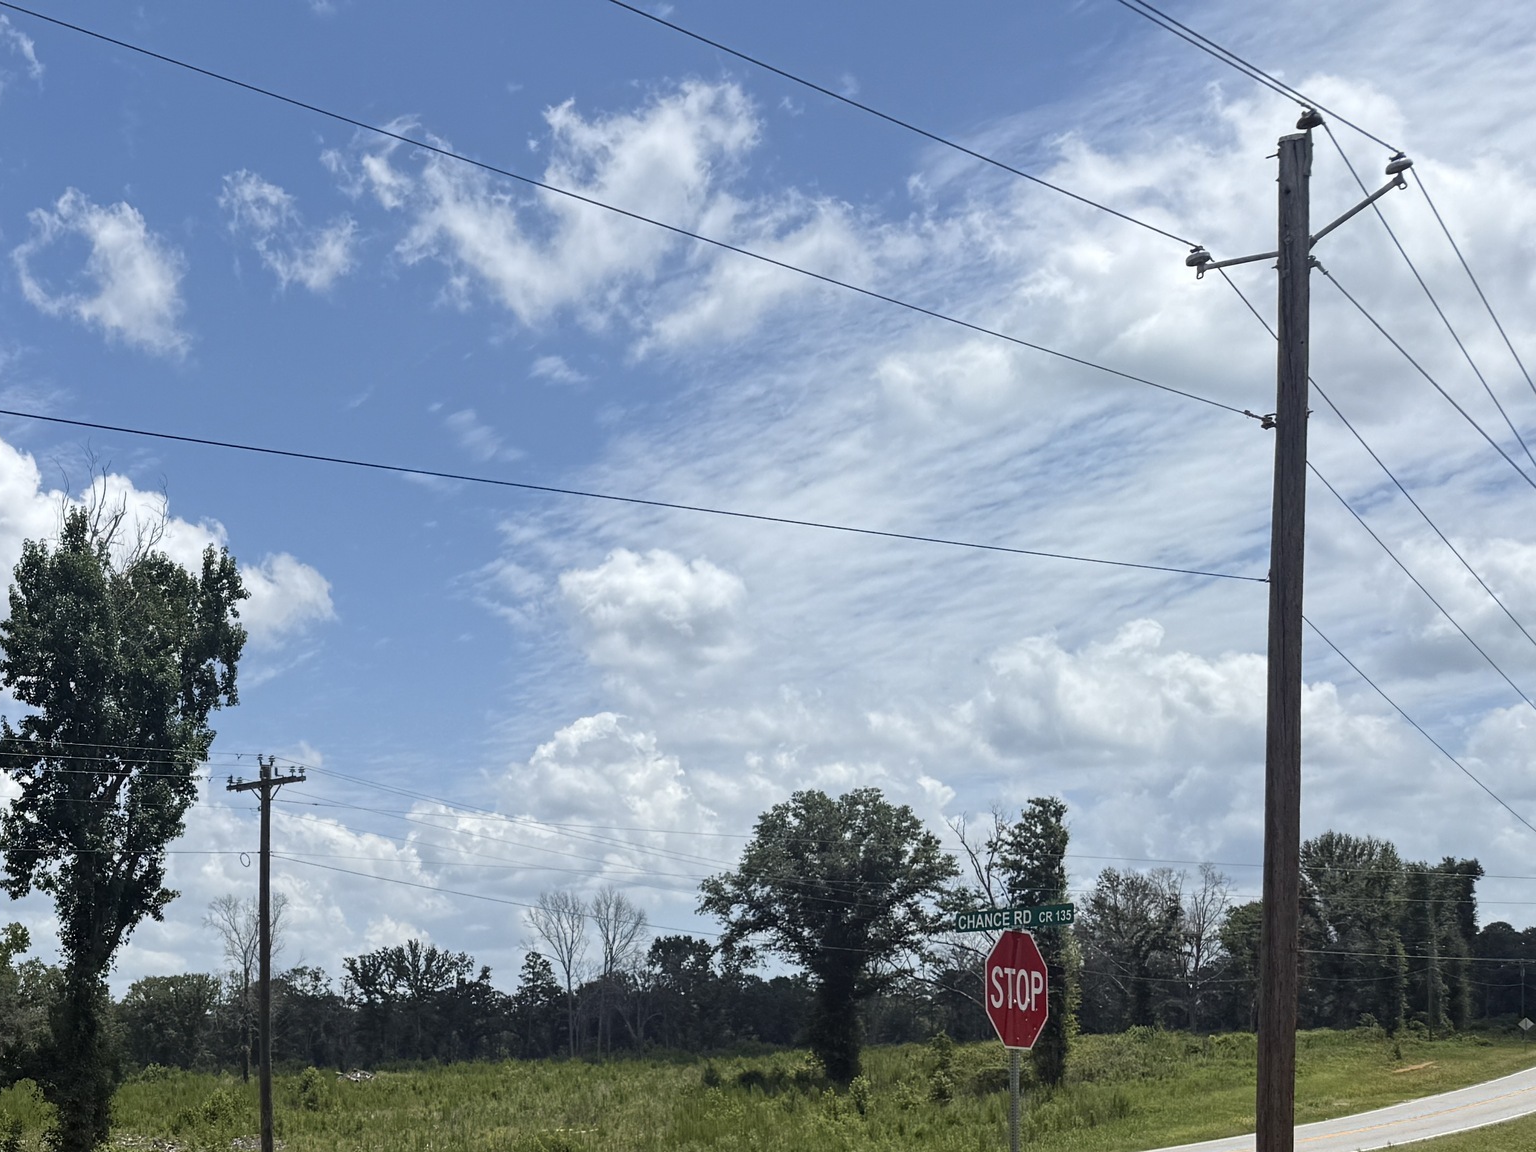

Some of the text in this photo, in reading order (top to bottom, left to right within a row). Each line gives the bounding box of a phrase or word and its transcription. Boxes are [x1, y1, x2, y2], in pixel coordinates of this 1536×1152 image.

[958, 909, 1072, 930] CHANCE RD CR 135
[991, 966, 1043, 1011] STOP
